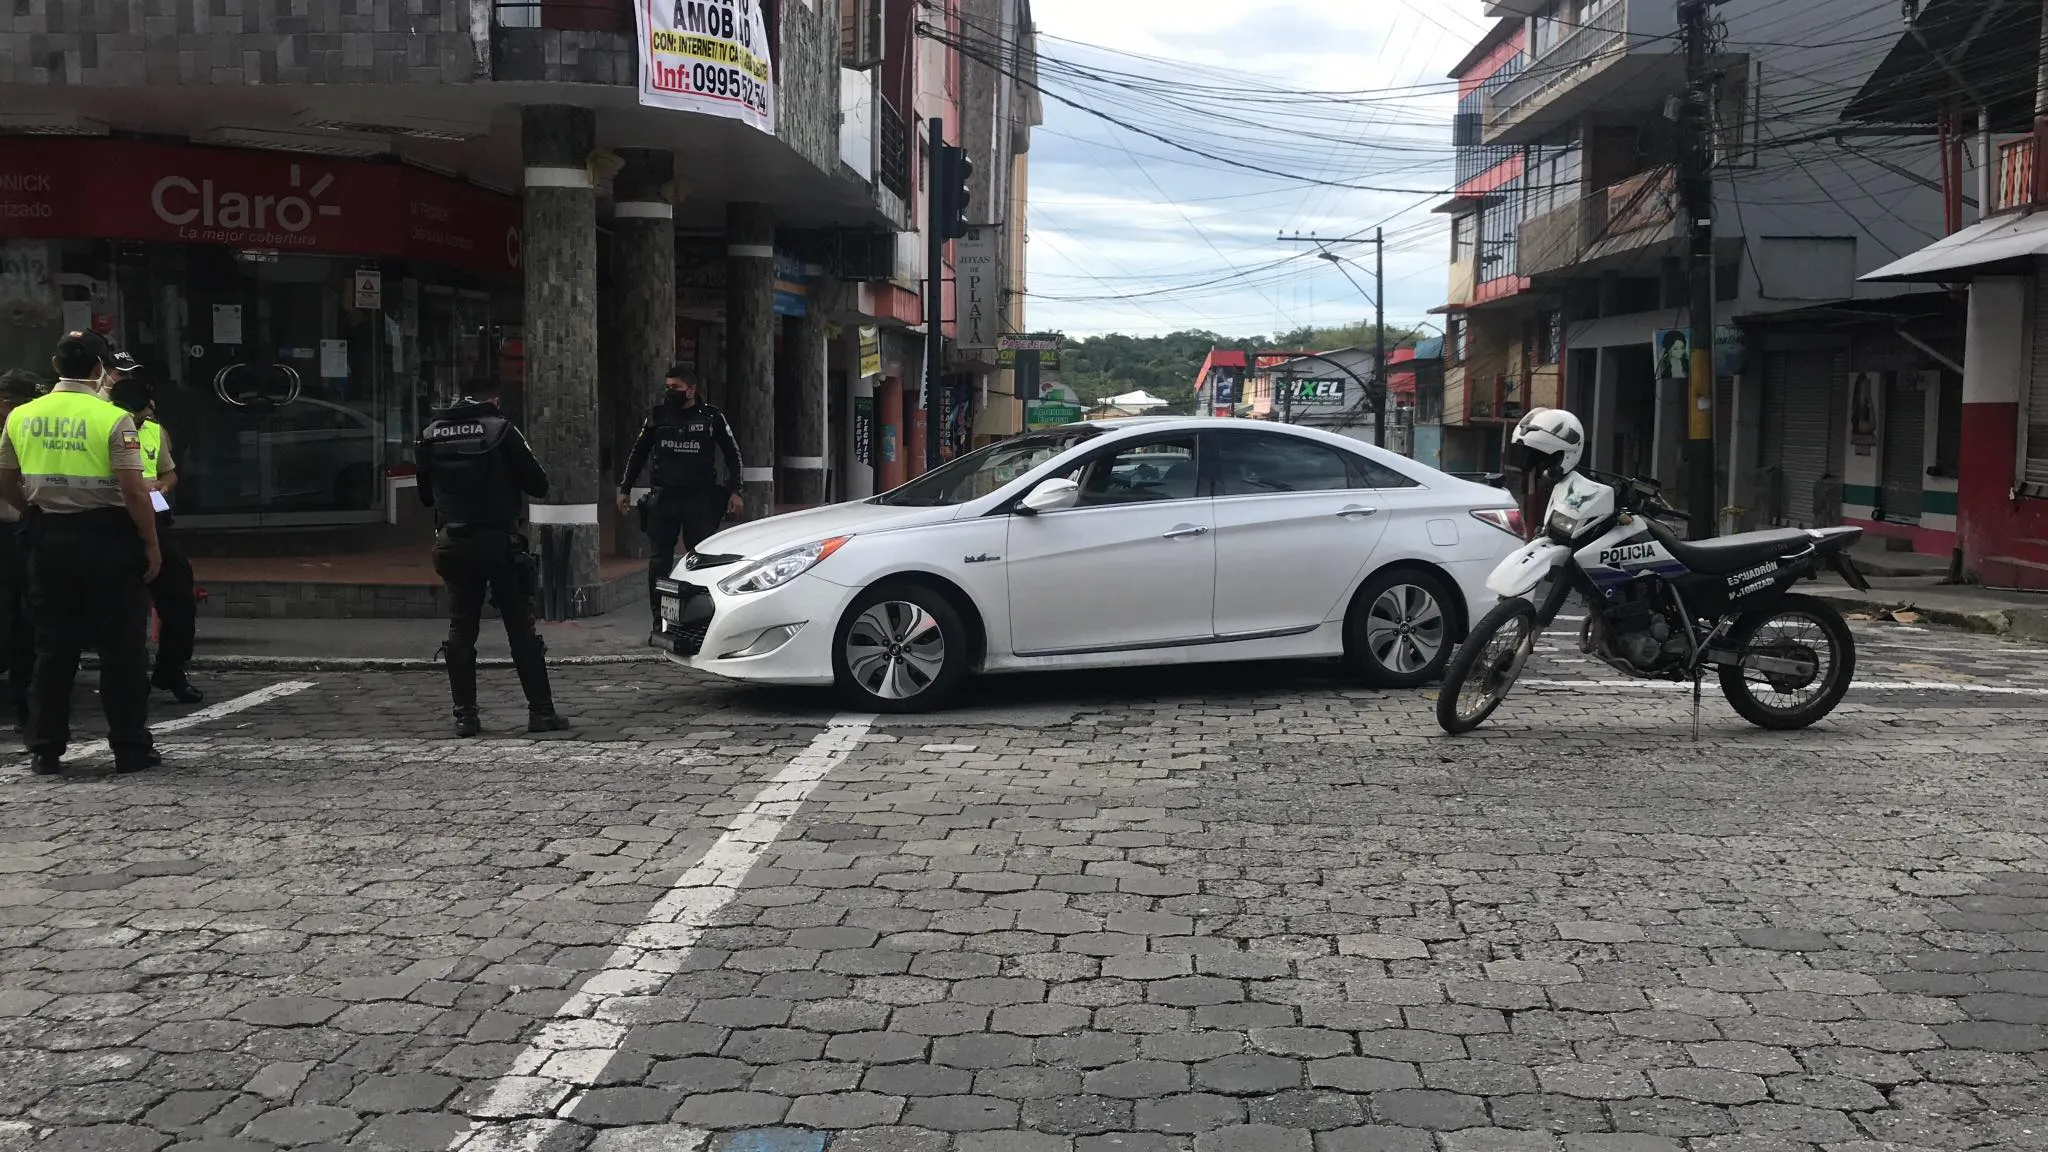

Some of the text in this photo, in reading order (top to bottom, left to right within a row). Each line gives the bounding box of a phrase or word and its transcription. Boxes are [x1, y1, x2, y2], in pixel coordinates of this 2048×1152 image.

[653, 32, 677, 52] CON:
[657, 61, 690, 90] Inf:
[151, 174, 313, 232] Claro
[178, 228, 317, 246] La mejor cobertura
[959, 256, 992, 264] JOYAS
[967, 275, 983, 344] PLATA
[43, 439, 87, 452] NACIONAL
[1599, 544, 1656, 564] POLICIA
[1726, 561, 1778, 587] ESCUADRÓN
